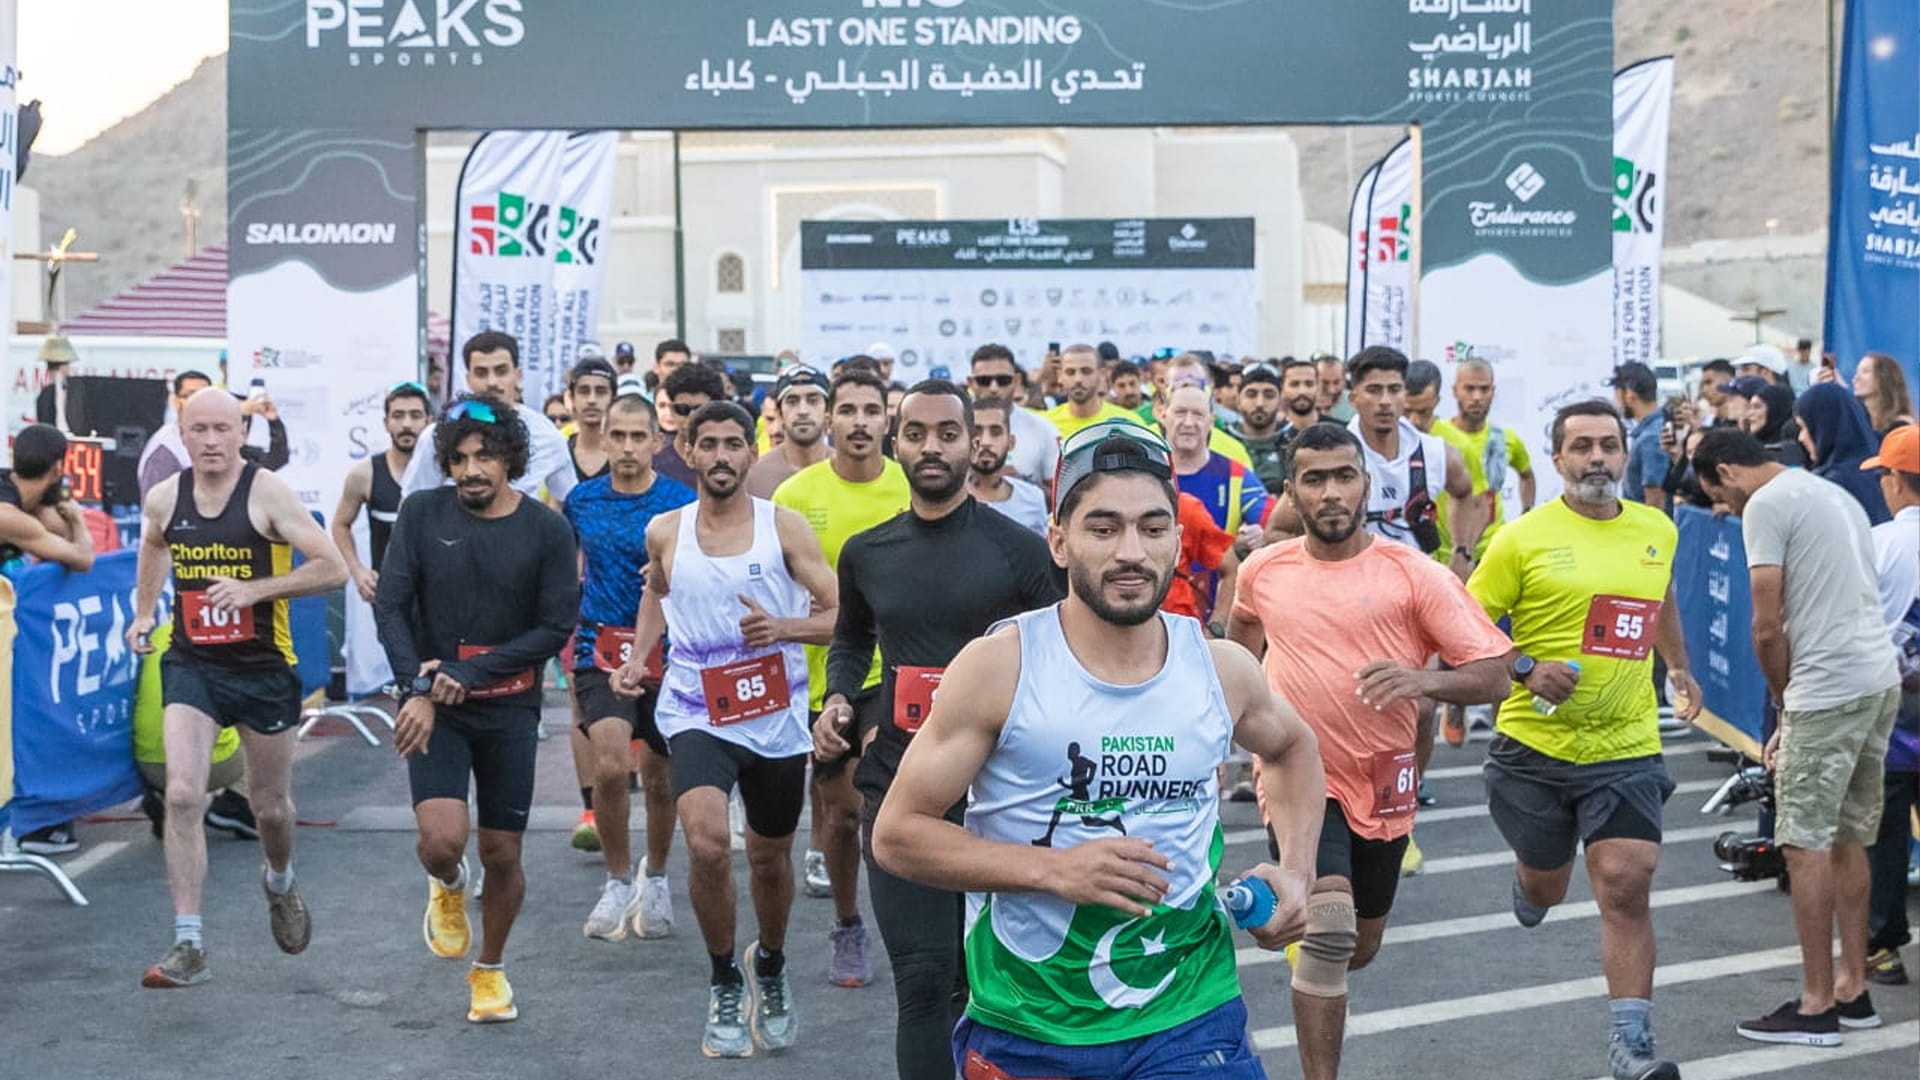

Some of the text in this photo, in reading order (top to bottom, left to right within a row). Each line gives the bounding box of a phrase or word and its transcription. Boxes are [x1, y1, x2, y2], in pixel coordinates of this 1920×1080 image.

[306, 0, 525, 47] PEAKS
[746, 16, 1082, 46] LAST ONE STANDING
[1408, 22, 1531, 60] الرياضي
[350, 53, 483, 65] SPORTS
[684, 59, 755, 97] كلباء
[785, 59, 919, 104] الجبلي
[928, 59, 1041, 97] الحفية
[1051, 60, 1145, 104] تحدي
[1408, 68, 1532, 90] SHARJAH
[1468, 202, 1577, 228] Endurance
[246, 223, 396, 243] SALOMON
[1623, 268, 1634, 296] ALL
[515, 286, 526, 310] ALL
[528, 284, 541, 371] FEDERATION
[1623, 301, 1634, 332] FOR
[171, 543, 252, 560] Chorlton
[173, 562, 253, 579] Runners
[1615, 613, 1643, 640] 55
[736, 675, 766, 702] 85
[1101, 736, 1174, 752] PAKISTAN
[1101, 754, 1167, 776] ROAD
[1397, 766, 1415, 793] 61
